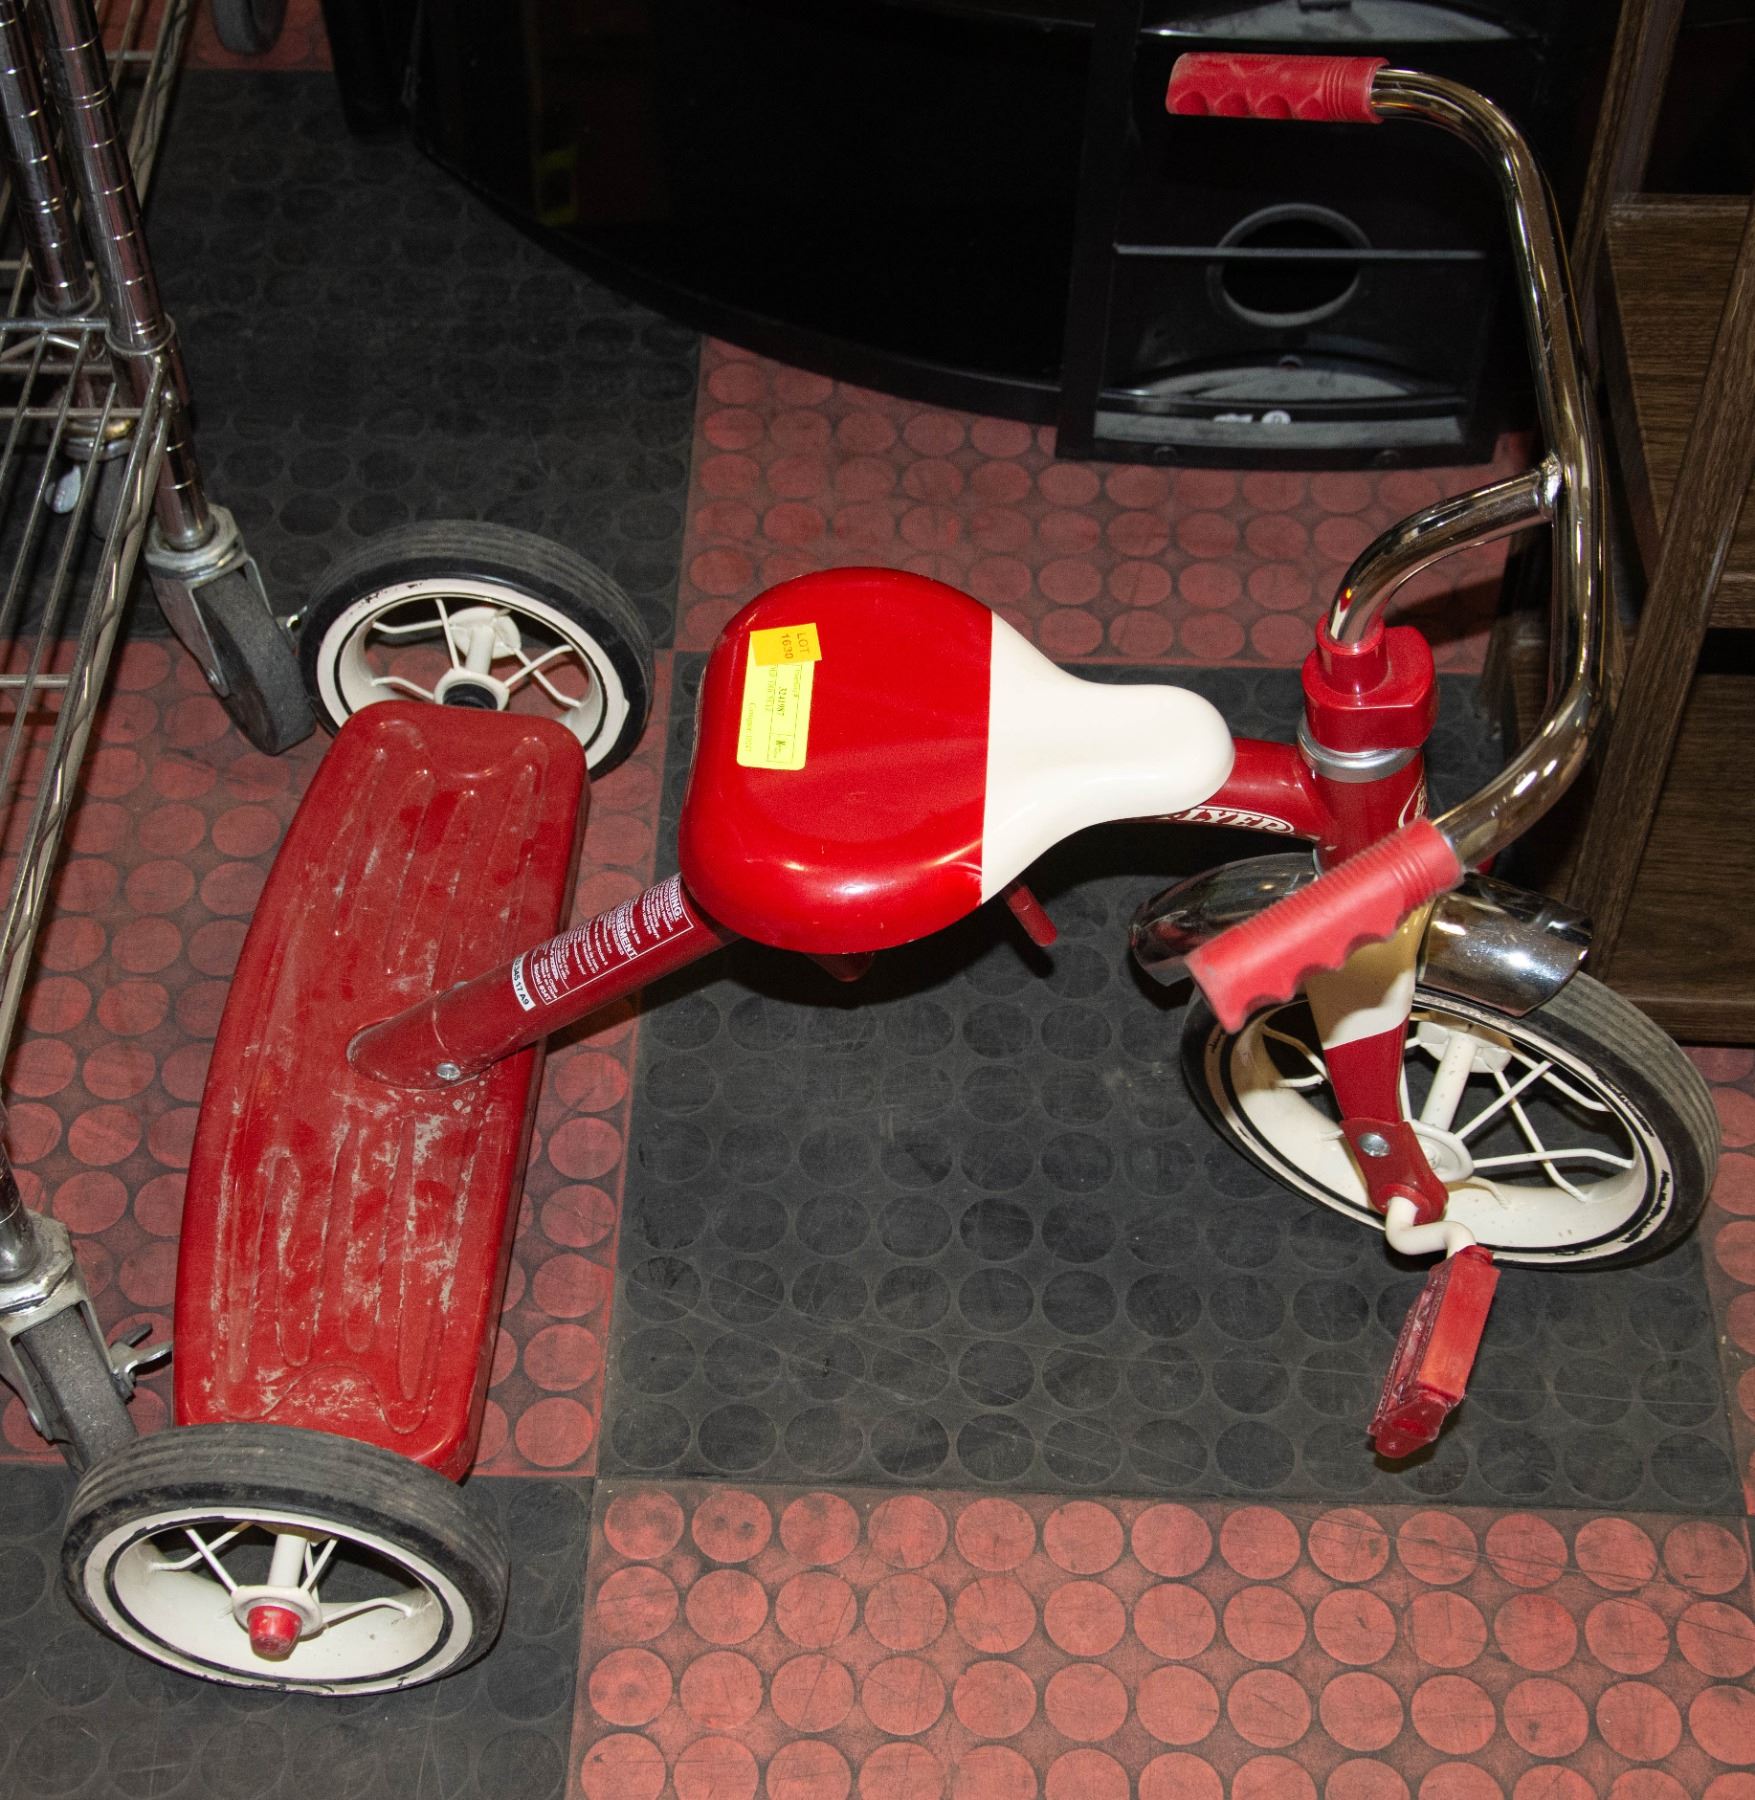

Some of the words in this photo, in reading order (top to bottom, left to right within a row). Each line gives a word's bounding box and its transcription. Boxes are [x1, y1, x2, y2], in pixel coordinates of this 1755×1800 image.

[797, 632, 810, 653] LOT
[1165, 808, 1290, 834] LYER
[519, 992, 530, 1006] A9
